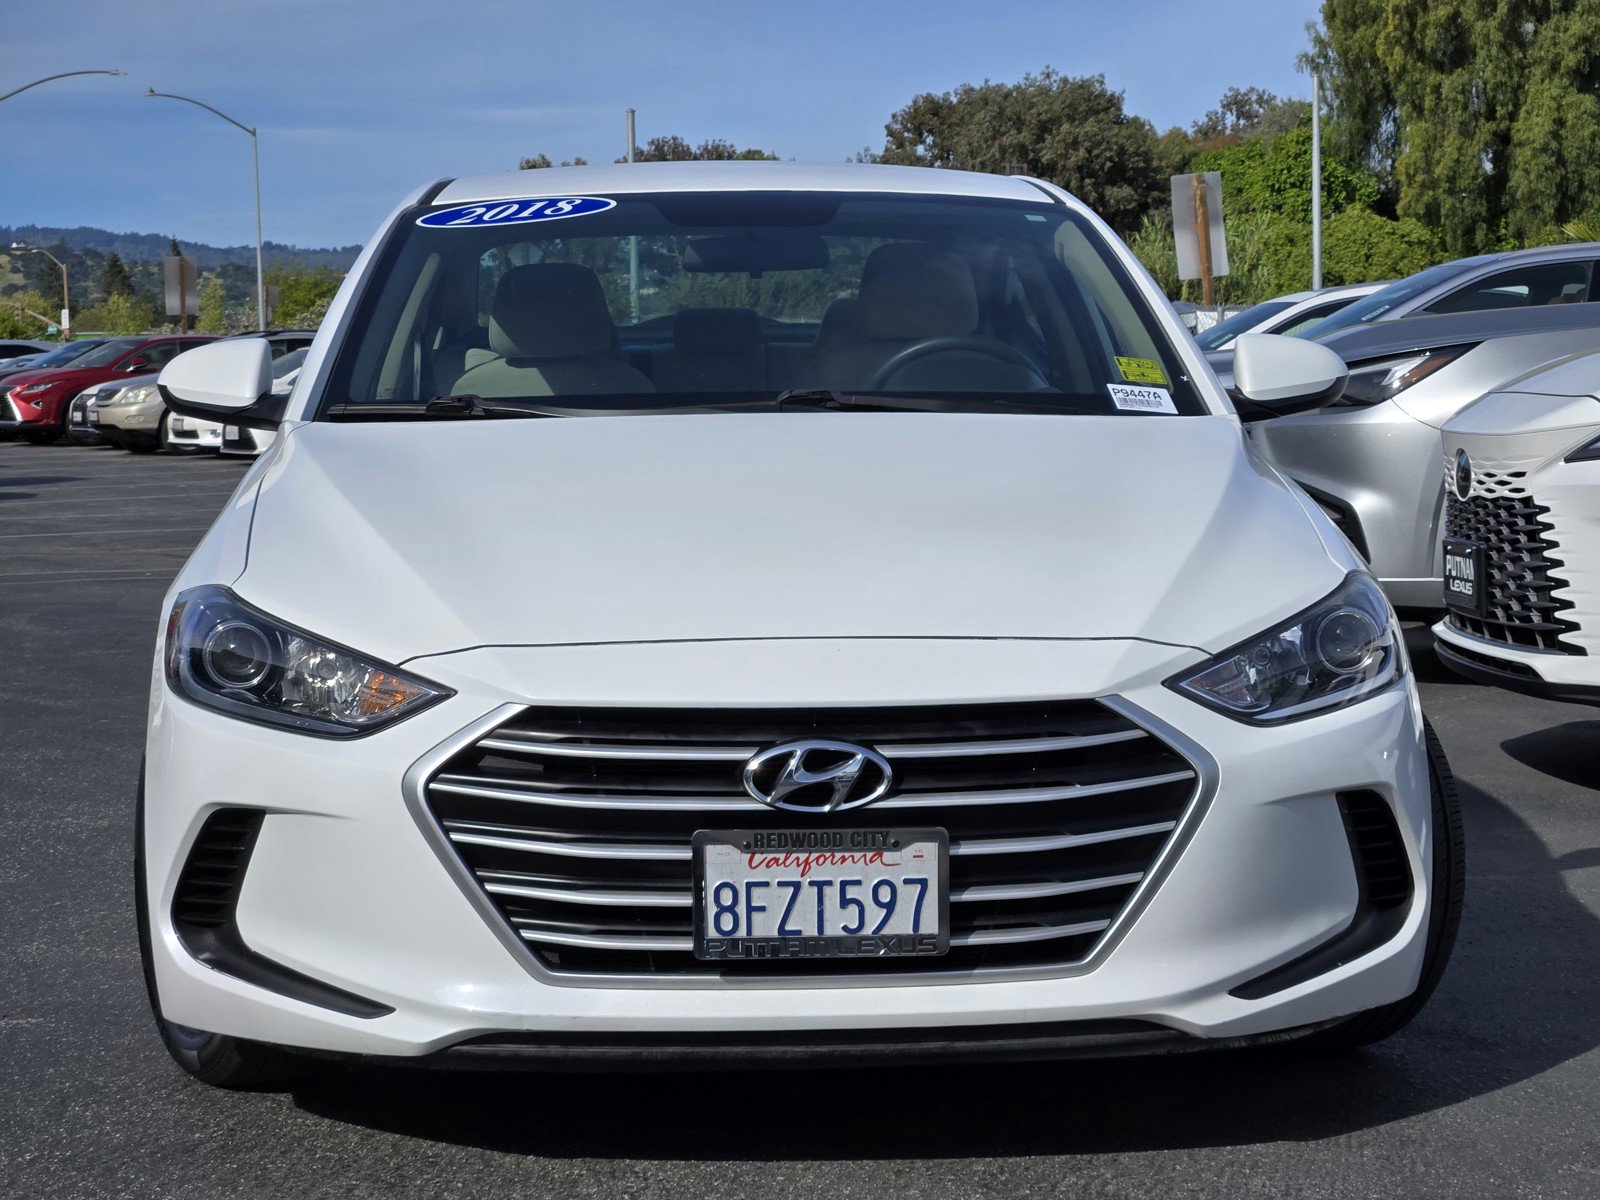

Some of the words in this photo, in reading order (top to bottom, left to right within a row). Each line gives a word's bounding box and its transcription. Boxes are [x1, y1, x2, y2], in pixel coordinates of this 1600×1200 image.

[446, 199, 582, 225] 2018
[1112, 388, 1162, 400] P9447A
[1450, 578, 1472, 595] LEXUS
[753, 832, 844, 849] REDWOOD
[850, 831, 891, 848] CITY
[748, 851, 901, 877] California
[714, 878, 928, 936] 8FZT597
[838, 938, 938, 956] LEXUS
